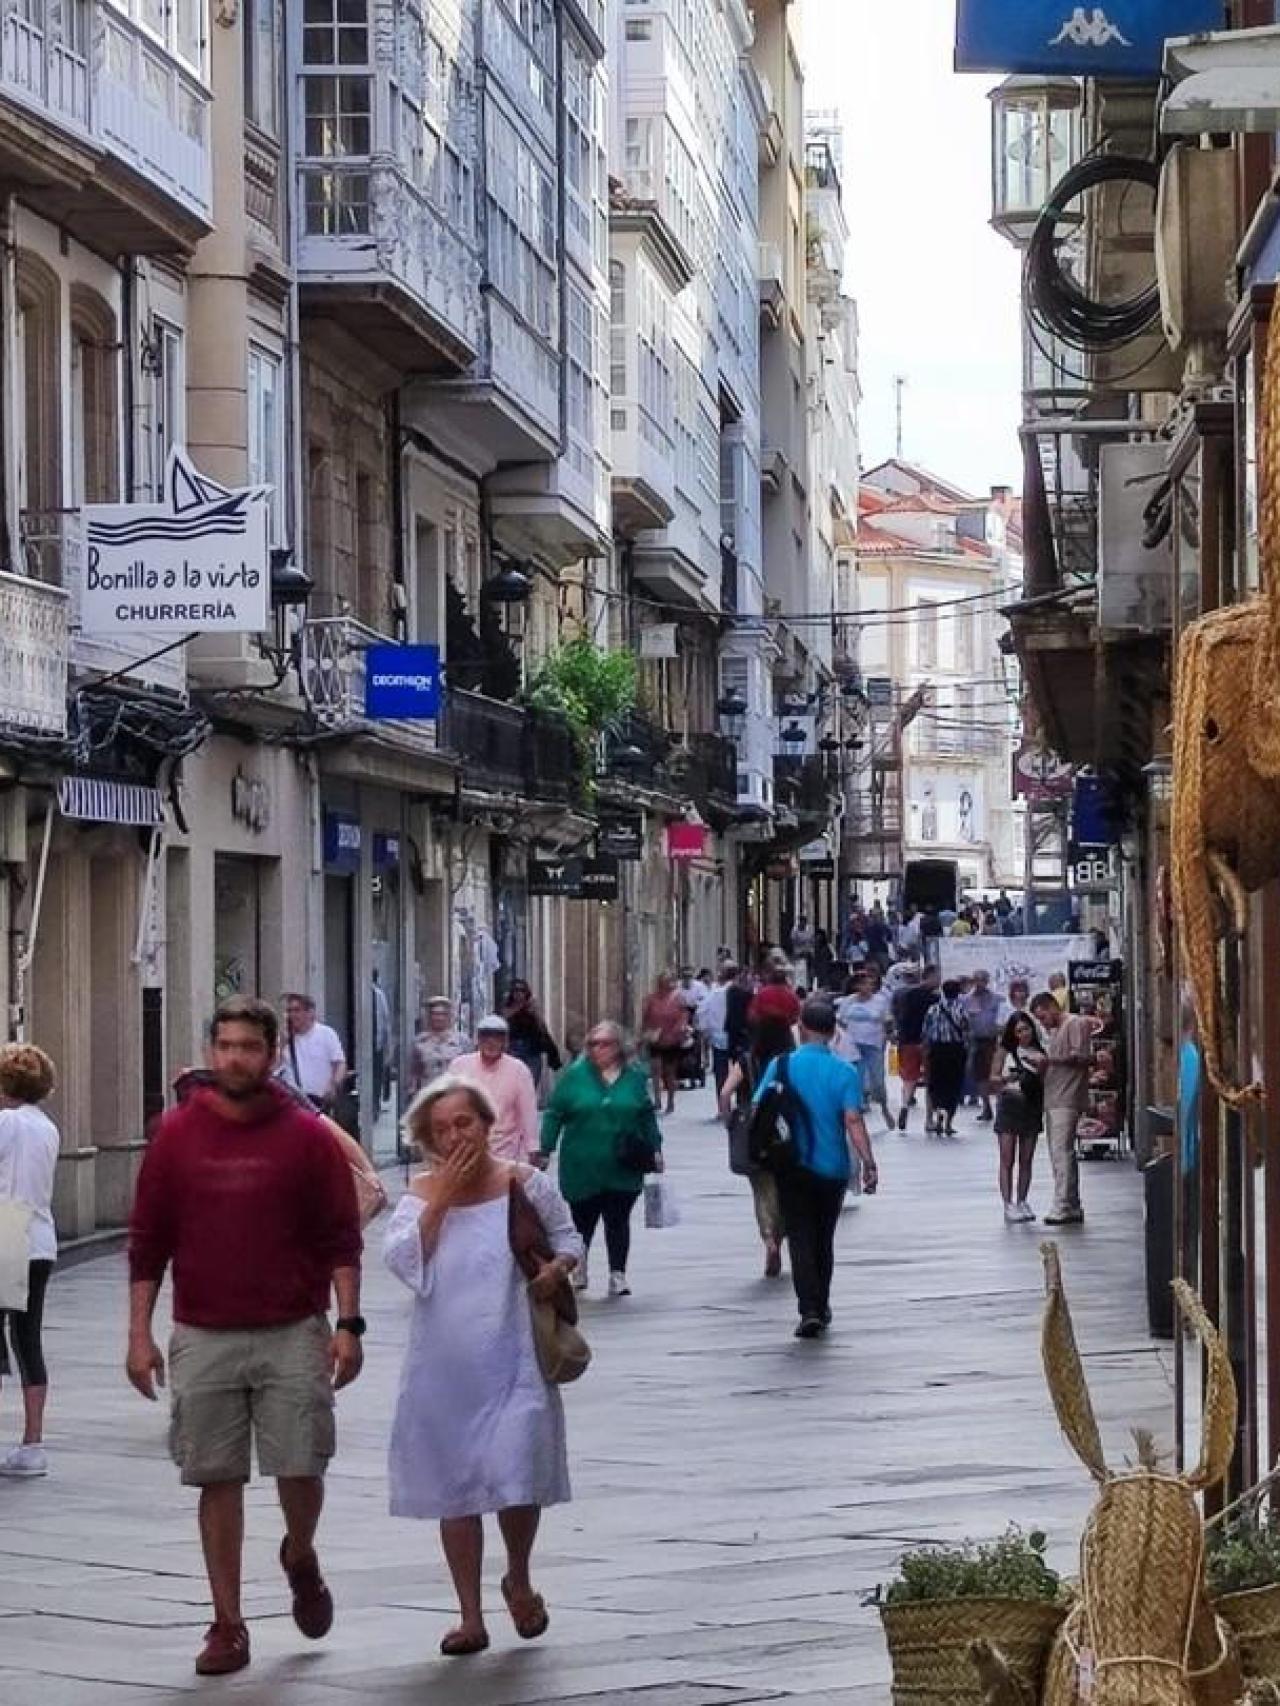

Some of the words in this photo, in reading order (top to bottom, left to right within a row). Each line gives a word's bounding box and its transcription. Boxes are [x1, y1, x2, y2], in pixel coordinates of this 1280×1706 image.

[87, 545, 159, 590] Bonilla
[163, 568, 176, 589] a
[183, 559, 201, 589] la
[207, 560, 260, 589] vista
[115, 600, 236, 621] CHURRERÍA
